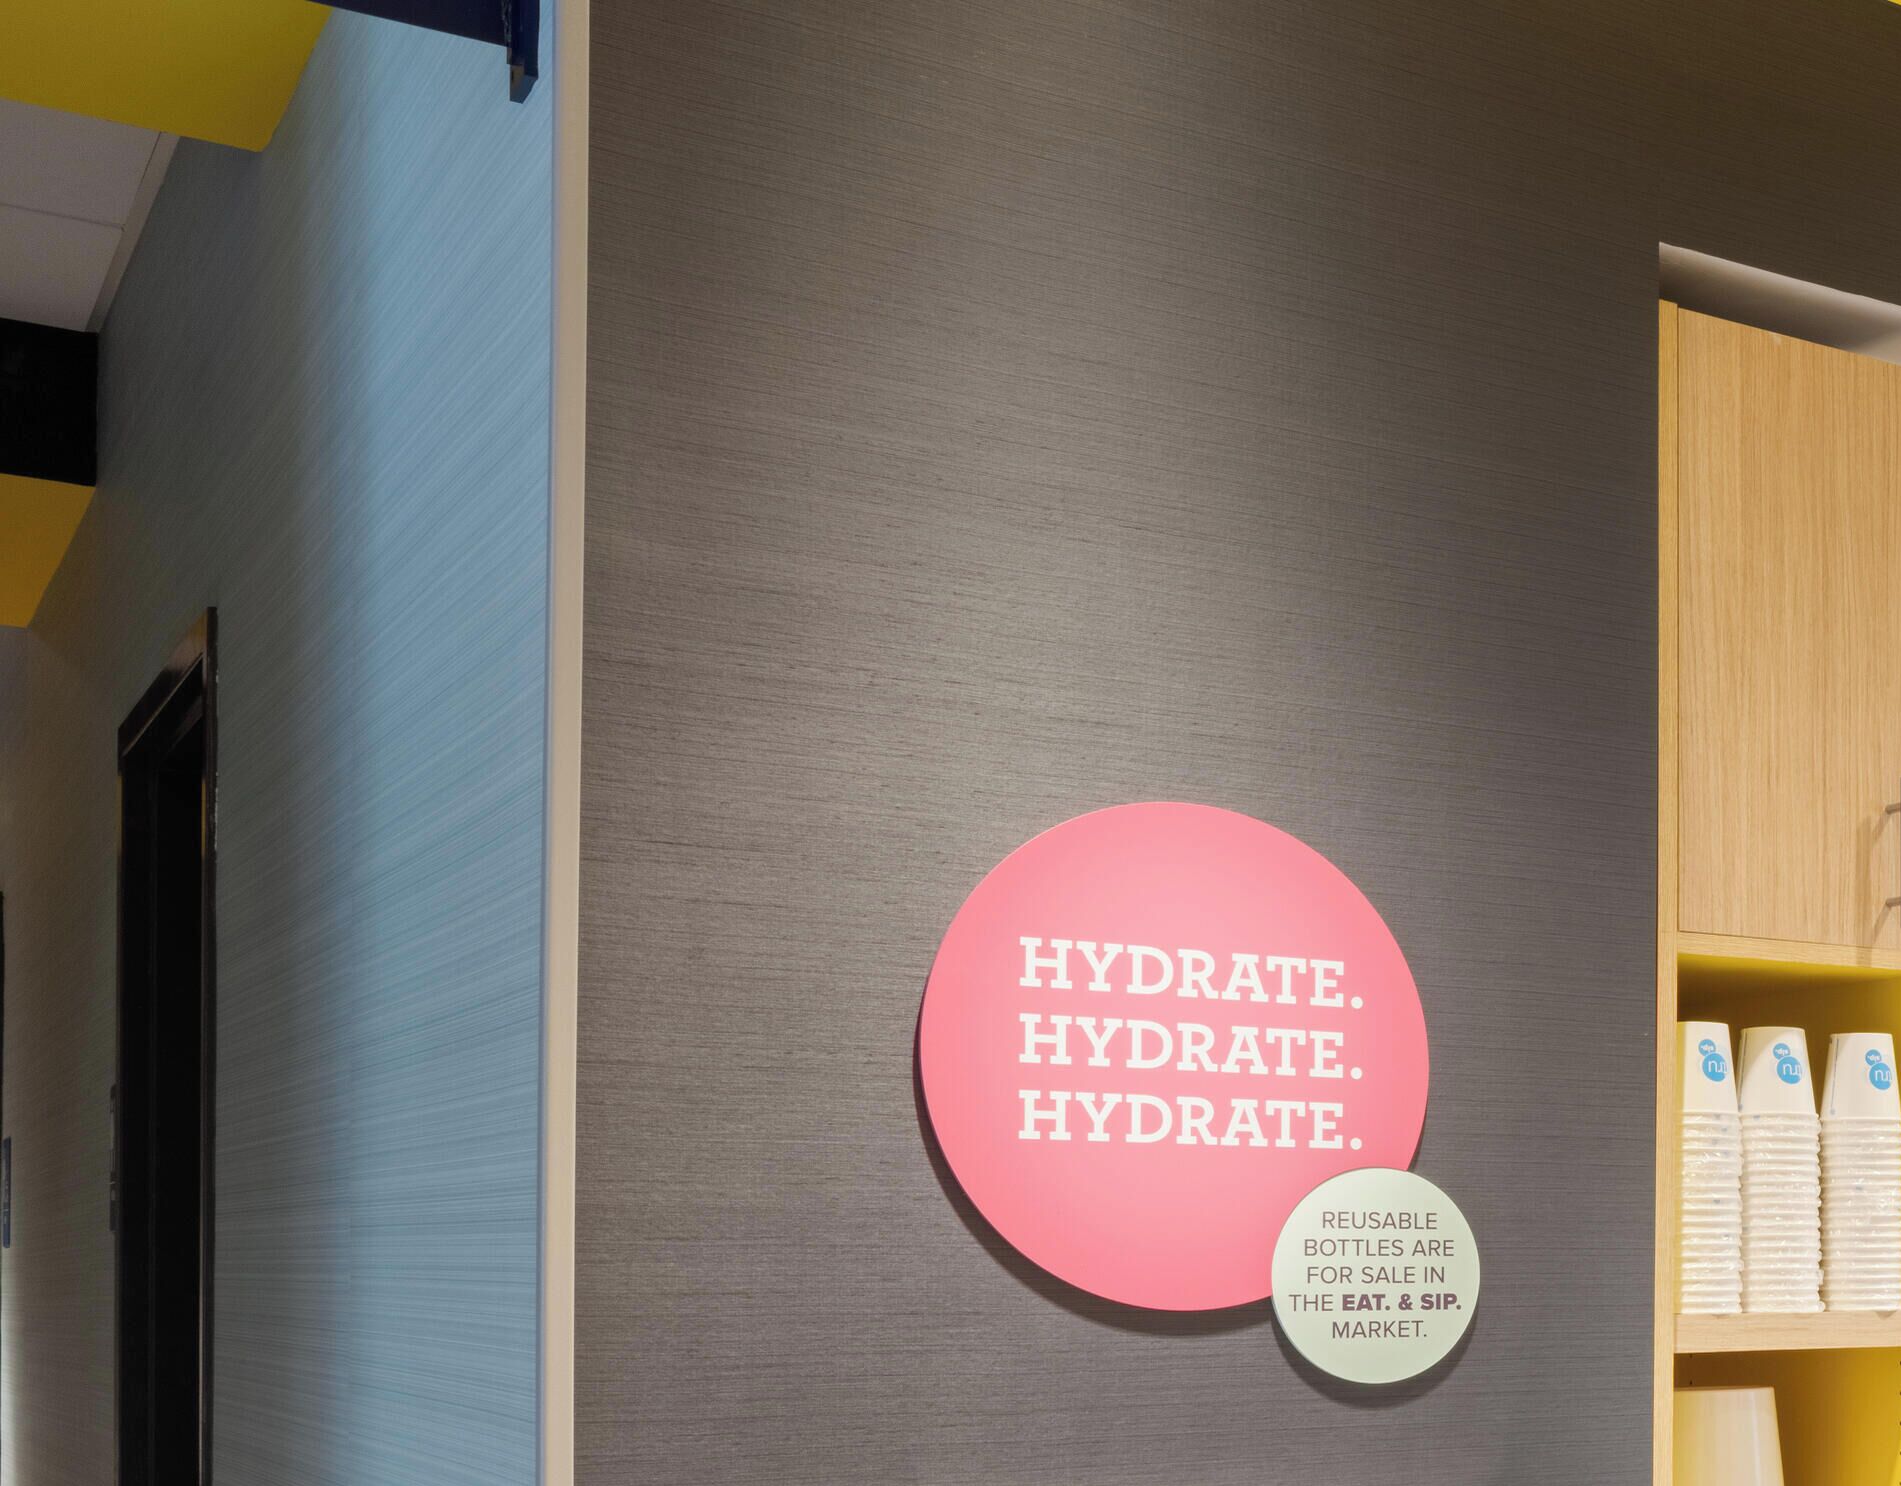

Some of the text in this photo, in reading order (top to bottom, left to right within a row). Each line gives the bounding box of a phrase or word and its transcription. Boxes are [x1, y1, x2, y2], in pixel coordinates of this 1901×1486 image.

[1019, 936, 1364, 1009] HYDRATE.
[1019, 1012, 1363, 1080] HYDRATE.
[1018, 1089, 1363, 1151] HYDRATE.
[1322, 1211, 1438, 1230] REUSABLE
[1304, 1239, 1454, 1257] BOTTLES ARE
[1307, 1266, 1445, 1284] FOR SALE IN
[1288, 1293, 1462, 1312] THE EAT. & SIP.
[1332, 1320, 1428, 1339] MARKET.
